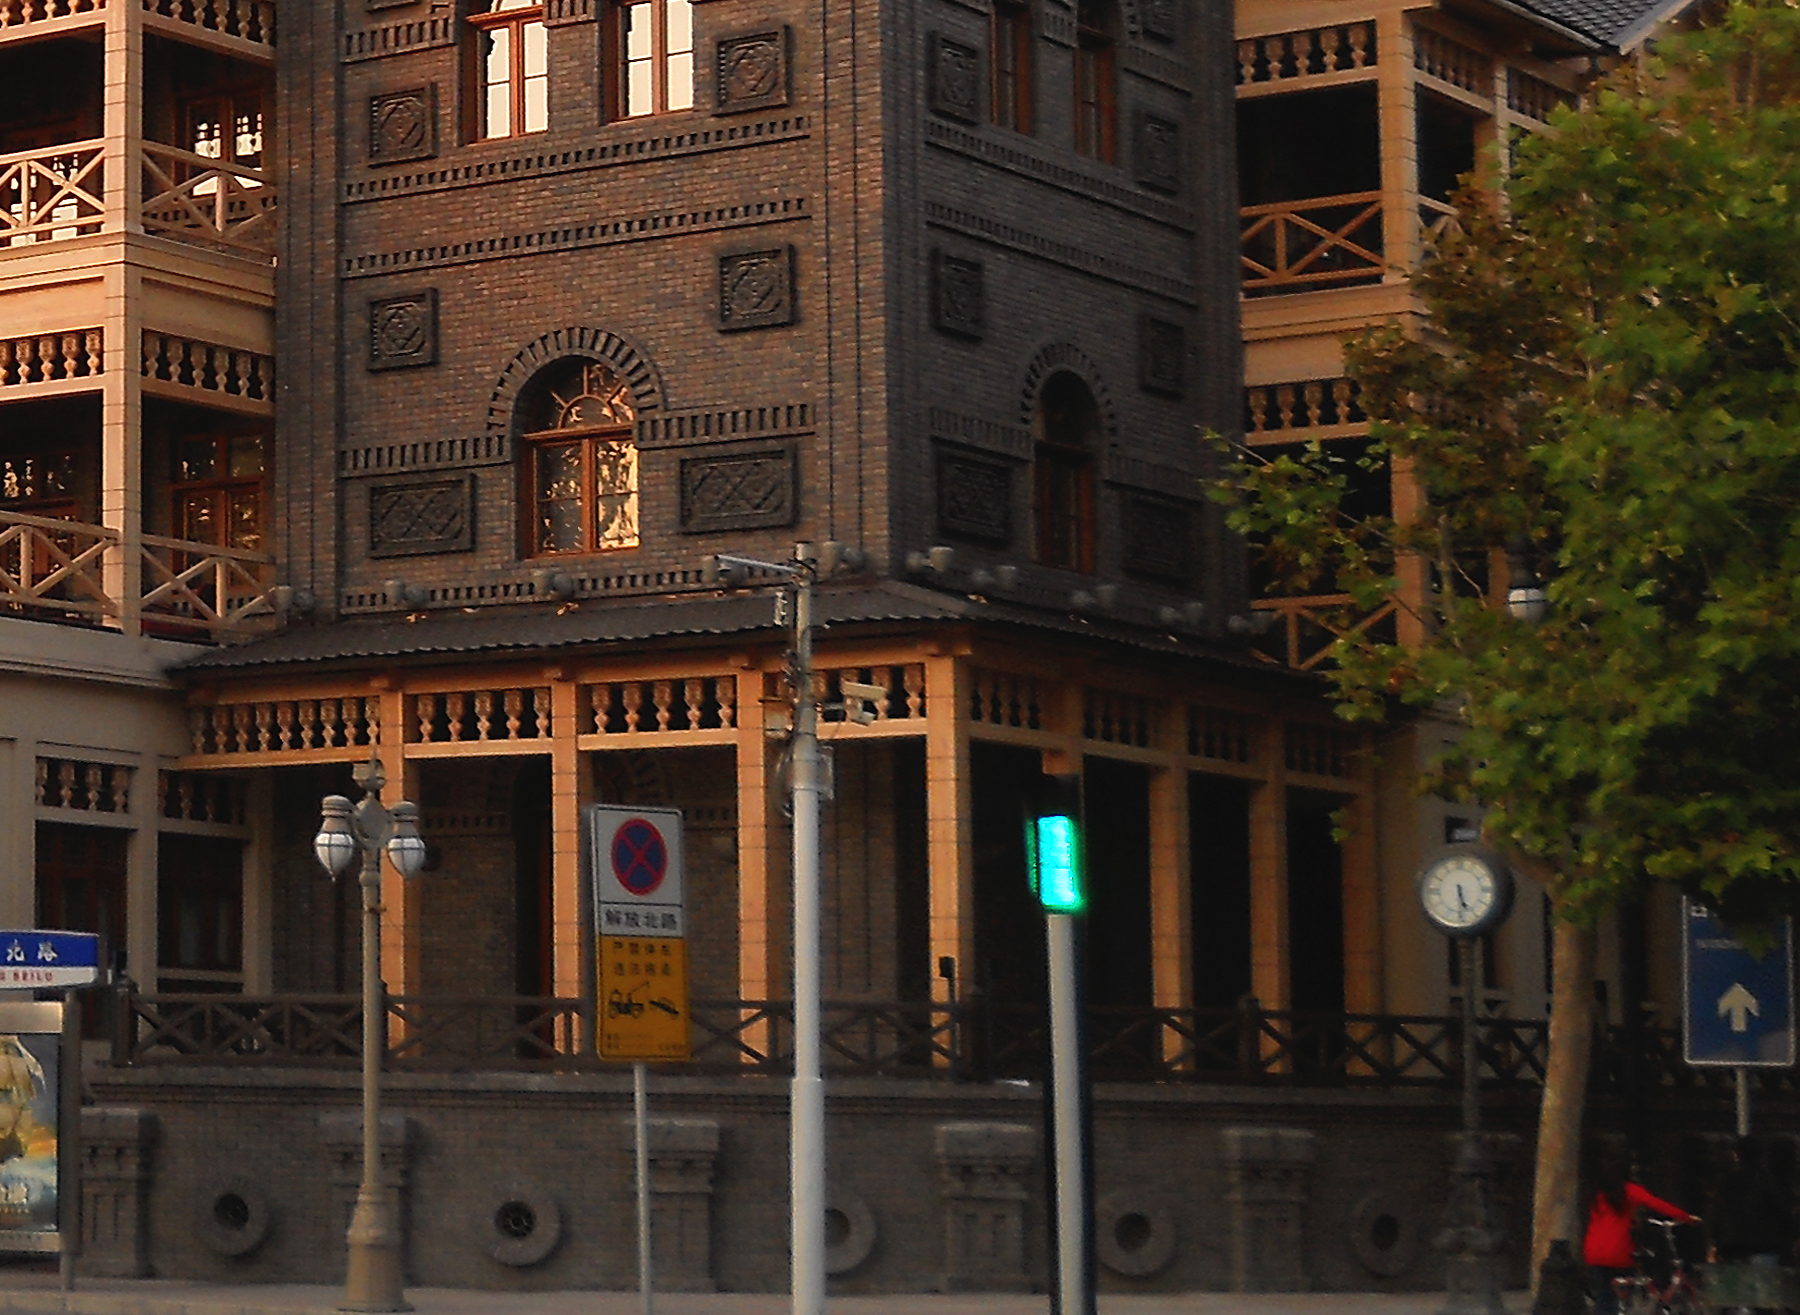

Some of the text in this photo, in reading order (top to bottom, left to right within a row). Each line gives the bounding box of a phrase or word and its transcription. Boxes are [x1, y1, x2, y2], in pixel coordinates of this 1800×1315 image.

[605, 909, 678, 930] 解放北路
[13, 970, 52, 982] BEILU
